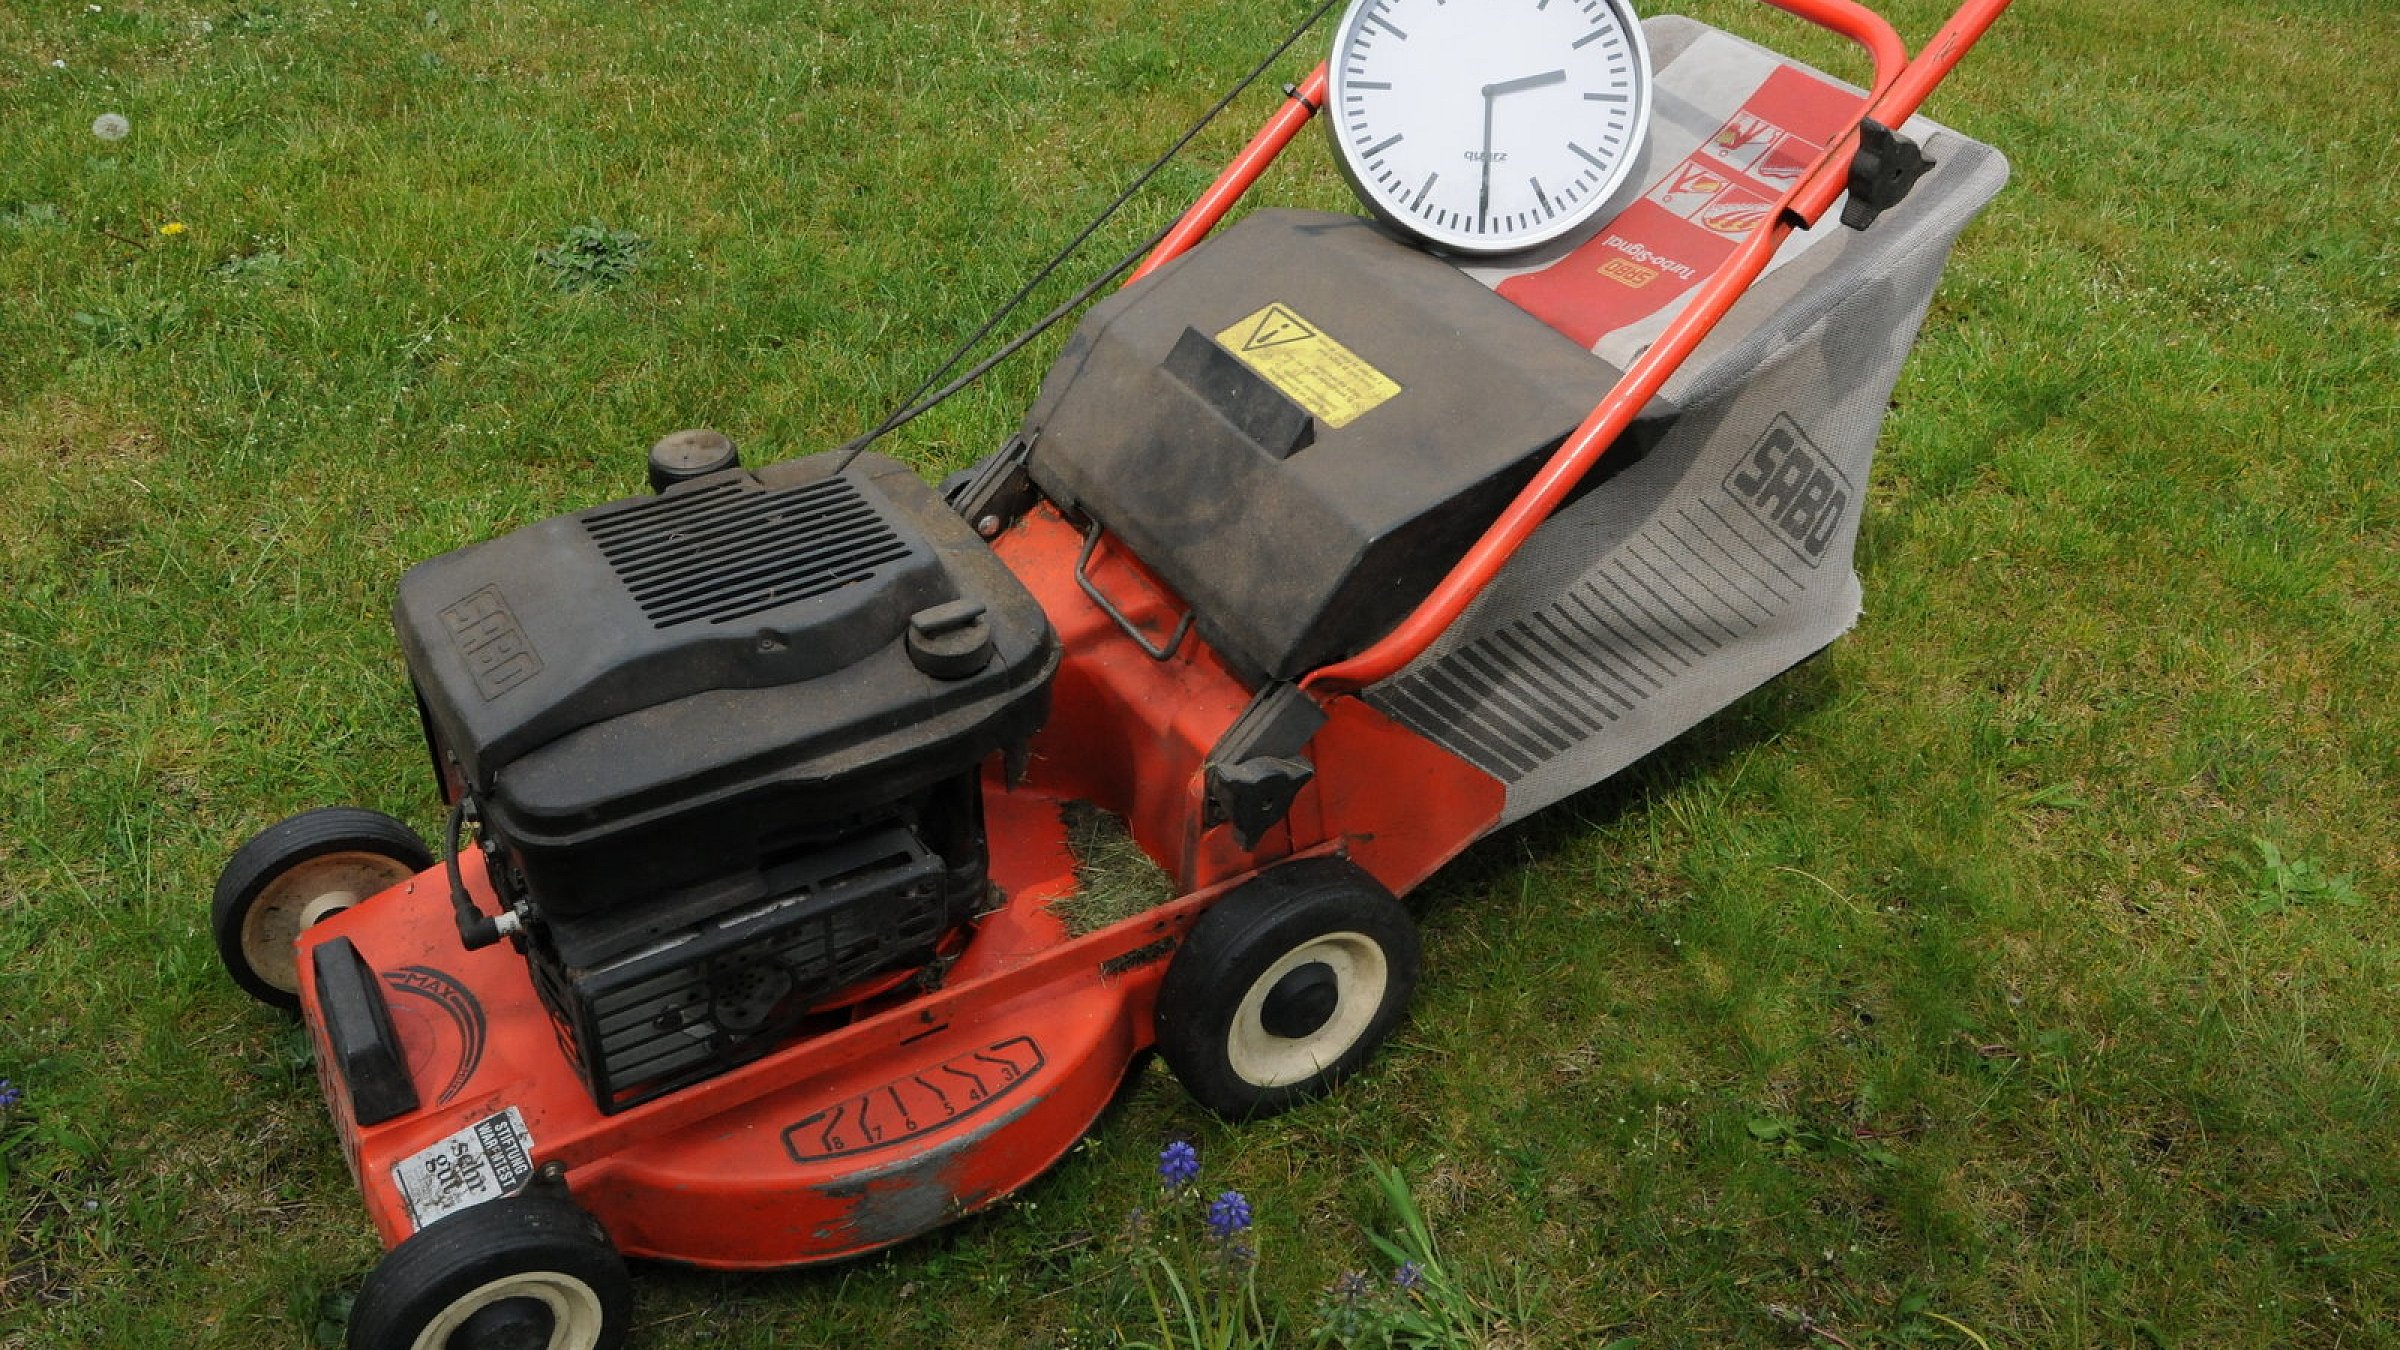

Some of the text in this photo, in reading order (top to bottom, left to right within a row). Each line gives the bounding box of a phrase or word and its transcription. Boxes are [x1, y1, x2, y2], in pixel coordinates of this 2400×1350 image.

[1464, 151, 1508, 162] quarz
[1602, 234, 1696, 280] Turbo-Signal
[1602, 260, 1656, 286] SABO
[1733, 428, 1847, 557] SABO
[443, 589, 534, 695] SABO
[404, 972, 458, 999] MAX
[831, 1067, 1013, 1150] 8 7 6 5 4 3
[478, 1121, 517, 1188] WARENTEST
[494, 1121, 529, 1175] STIFTUNG
